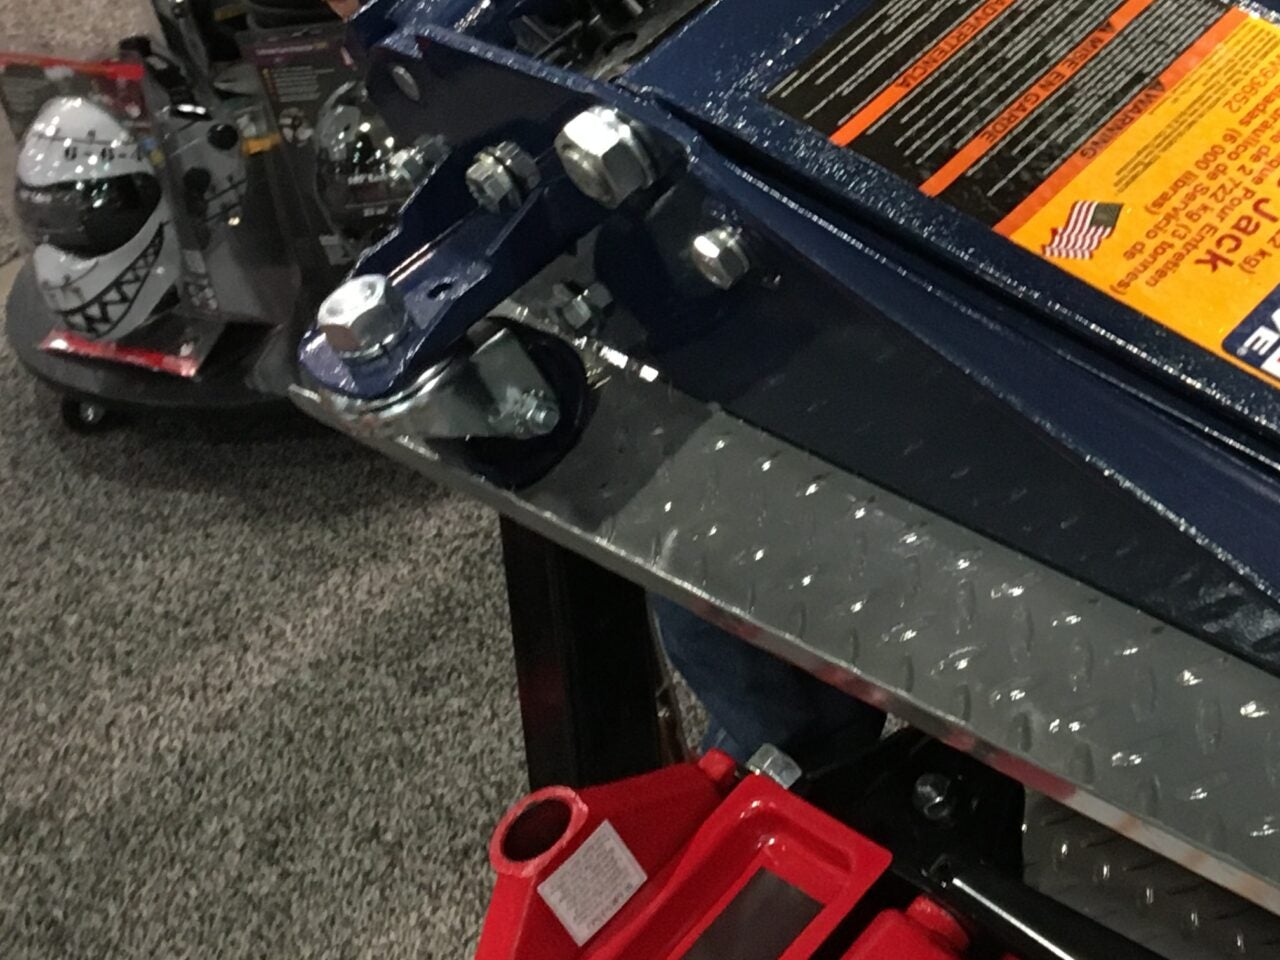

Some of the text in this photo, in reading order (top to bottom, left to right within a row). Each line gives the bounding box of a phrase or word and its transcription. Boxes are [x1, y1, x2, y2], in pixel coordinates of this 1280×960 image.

[977, 34, 1103, 144] MISE EN GARDE
[1076, 89, 1159, 161] WARNING
[1215, 125, 1244, 145] (6
[1190, 141, 1227, 171] 000
[1246, 143, 1276, 166] de
[1203, 161, 1232, 183] de
[1234, 163, 1255, 177] 2
[1140, 167, 1200, 218] libras)
[1206, 174, 1243, 204] 722
[1210, 184, 1257, 224] Pour
[1141, 179, 1212, 243] Servicio
[1180, 199, 1215, 225] kg
[1163, 219, 1194, 242] (3
[1119, 239, 1150, 263] de
[1142, 220, 1220, 291] Entretien
[1234, 245, 1274, 277] kg)
[1106, 236, 1176, 298] tonnes)
